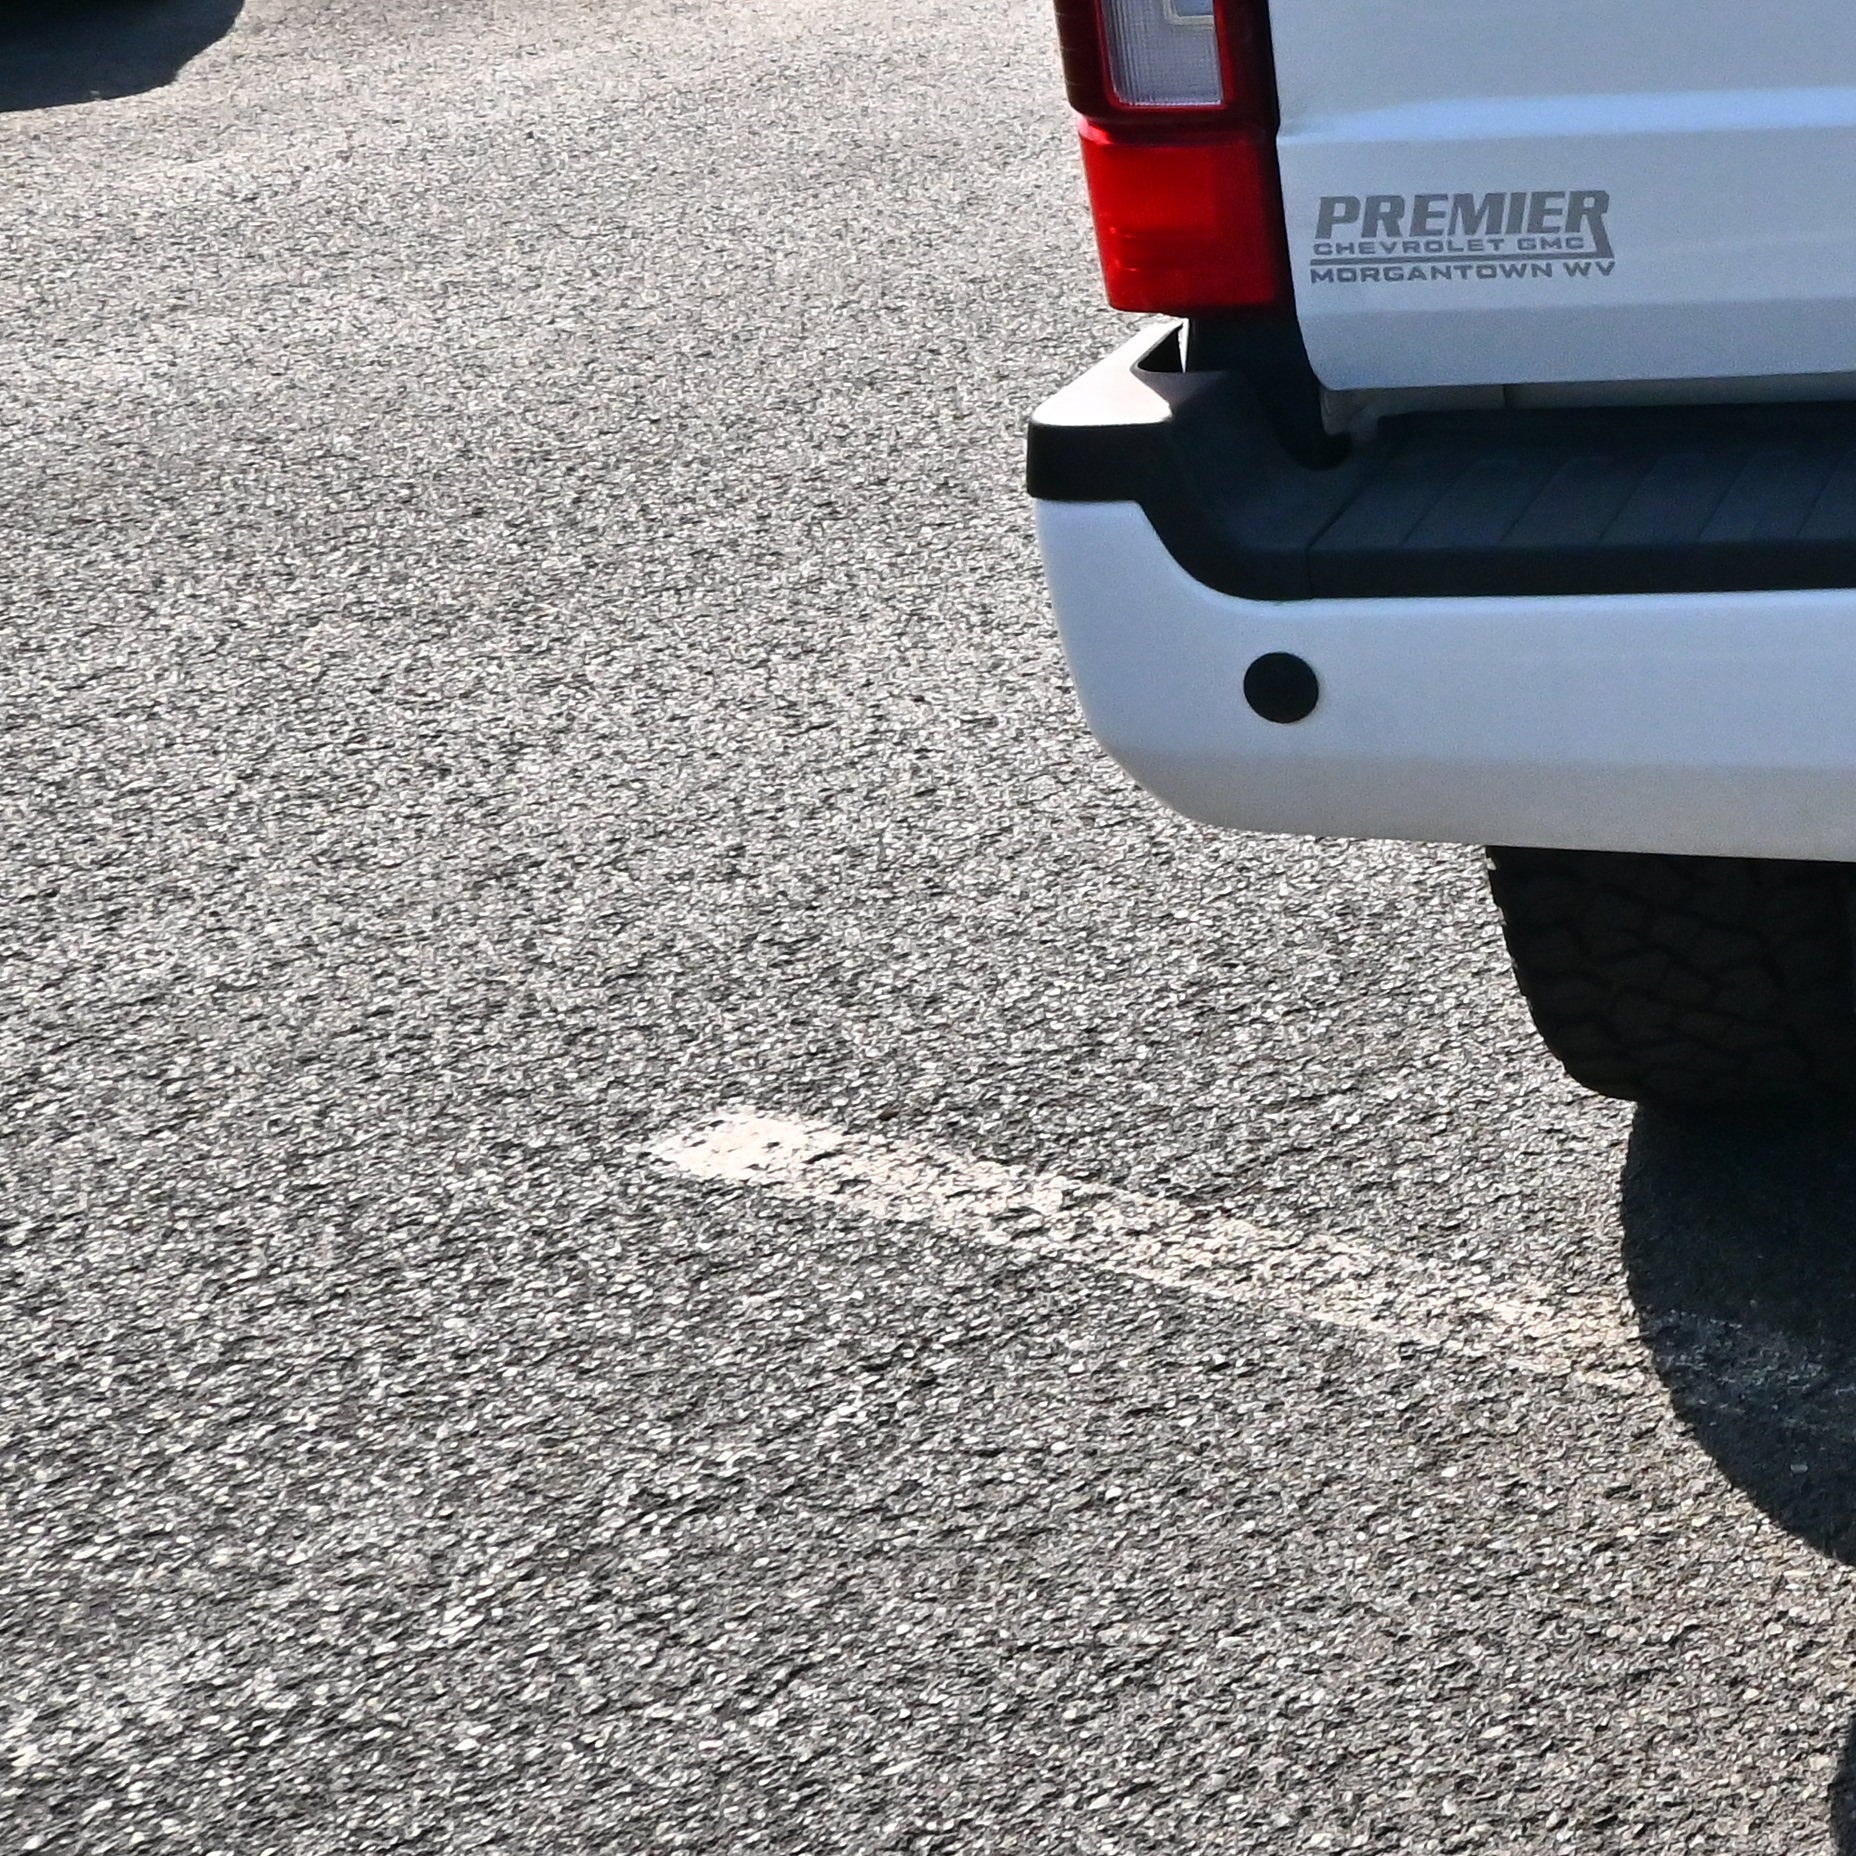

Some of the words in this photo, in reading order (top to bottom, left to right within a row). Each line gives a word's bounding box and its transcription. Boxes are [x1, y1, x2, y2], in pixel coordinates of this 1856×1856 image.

[1314, 189, 1614, 257] PREMIER
[1312, 237, 1505, 256] CHEVROLET
[1517, 236, 1585, 251] GMC
[1310, 262, 1553, 284] MORGANTOWN
[1563, 260, 1616, 277] WV
